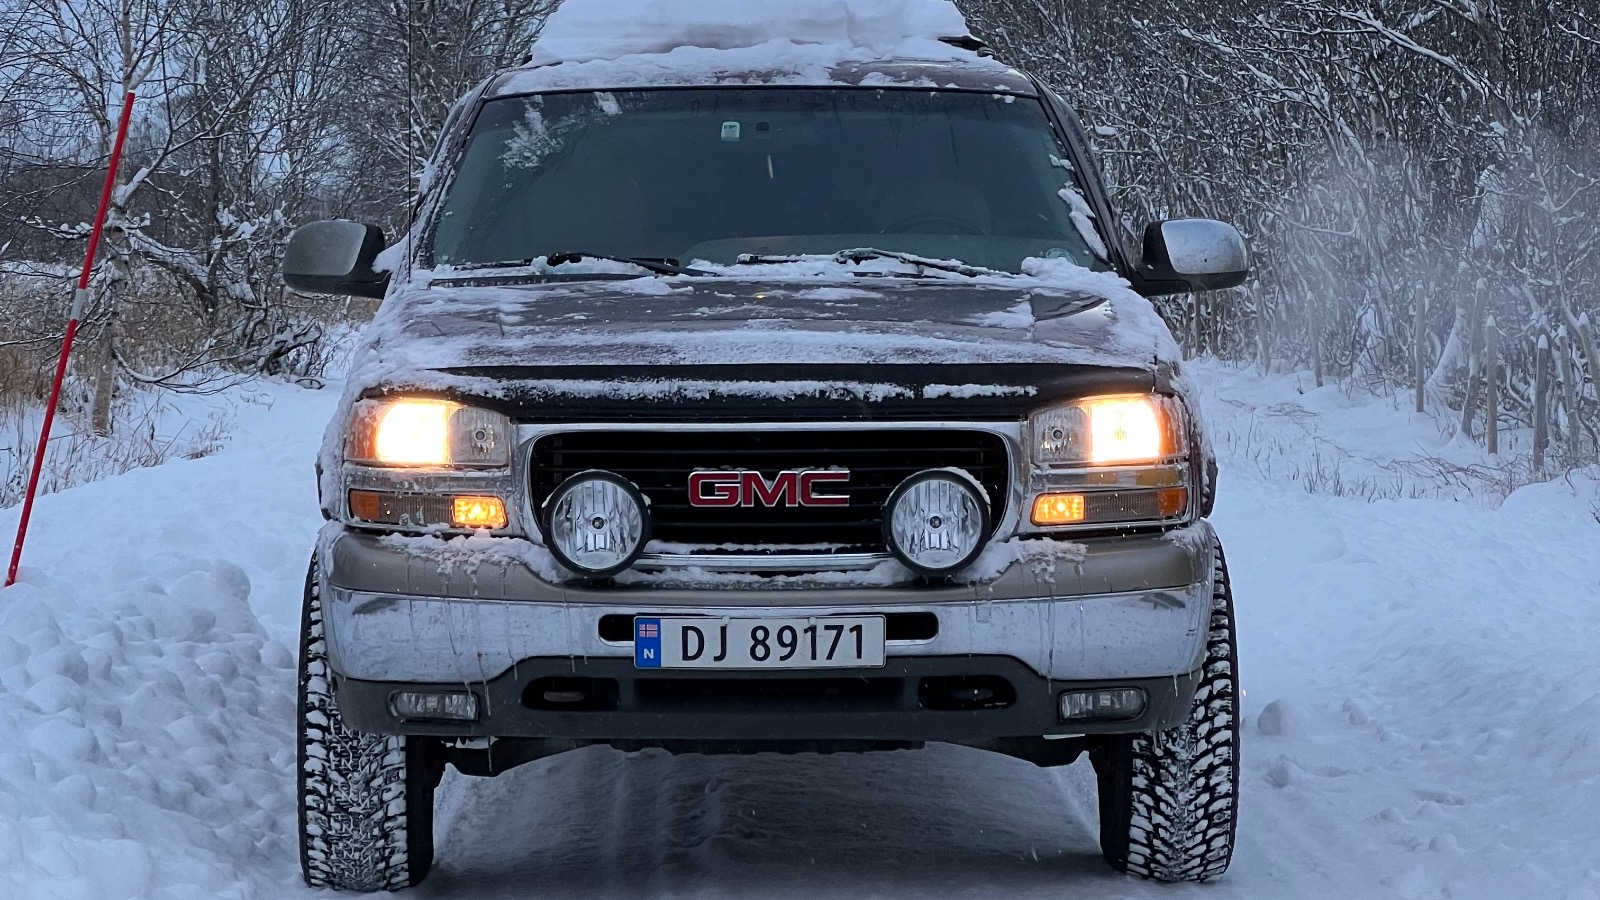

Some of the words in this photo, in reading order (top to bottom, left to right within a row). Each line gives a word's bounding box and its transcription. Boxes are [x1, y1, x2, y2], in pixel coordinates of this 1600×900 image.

[688, 470, 850, 507] GMC
[643, 649, 654, 659] N
[681, 625, 728, 661] DJ
[749, 624, 863, 661] 89171
